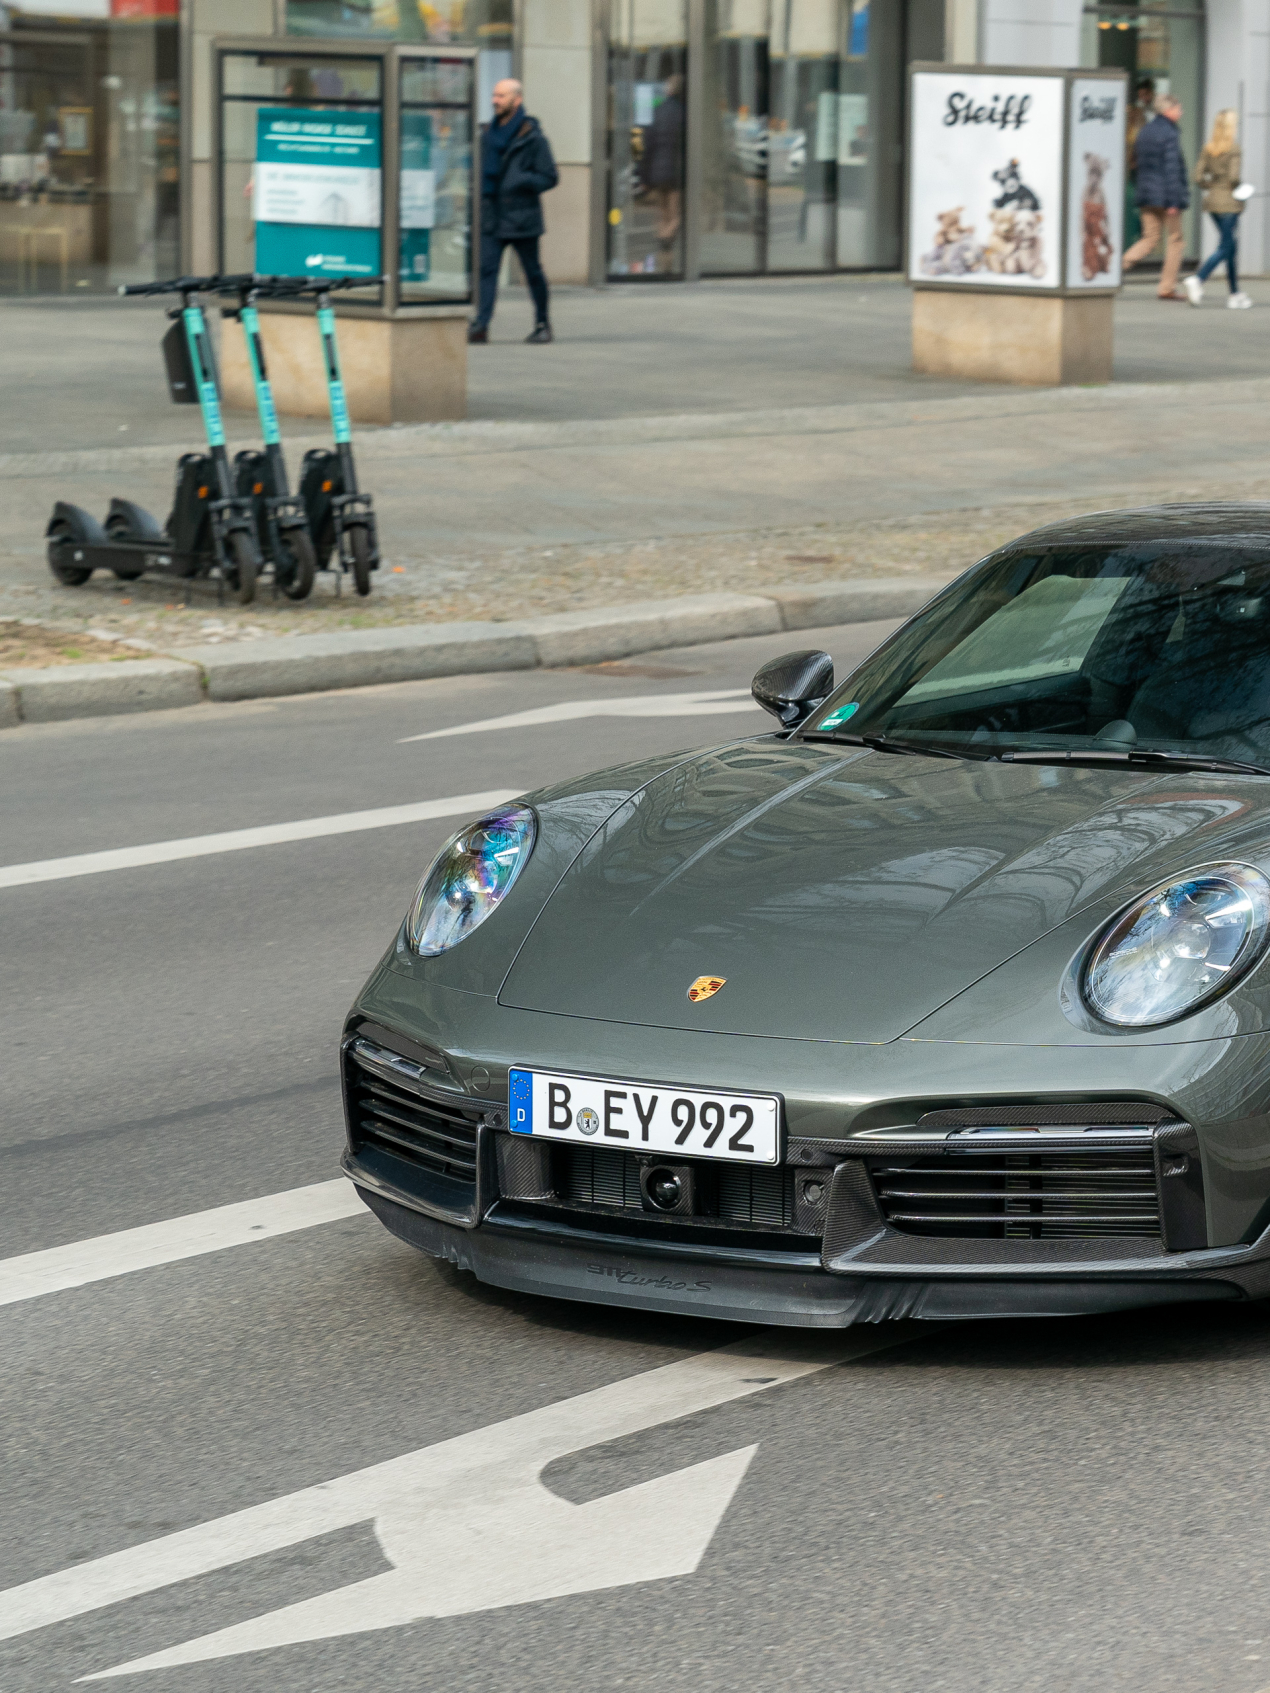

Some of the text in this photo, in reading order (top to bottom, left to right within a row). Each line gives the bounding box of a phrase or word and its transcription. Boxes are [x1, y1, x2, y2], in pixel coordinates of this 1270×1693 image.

[943, 91, 1031, 130] Steiff
[516, 1107, 526, 1122] D
[548, 1082, 573, 1130] B
[604, 1089, 658, 1142] EY
[671, 1098, 754, 1153] 992
